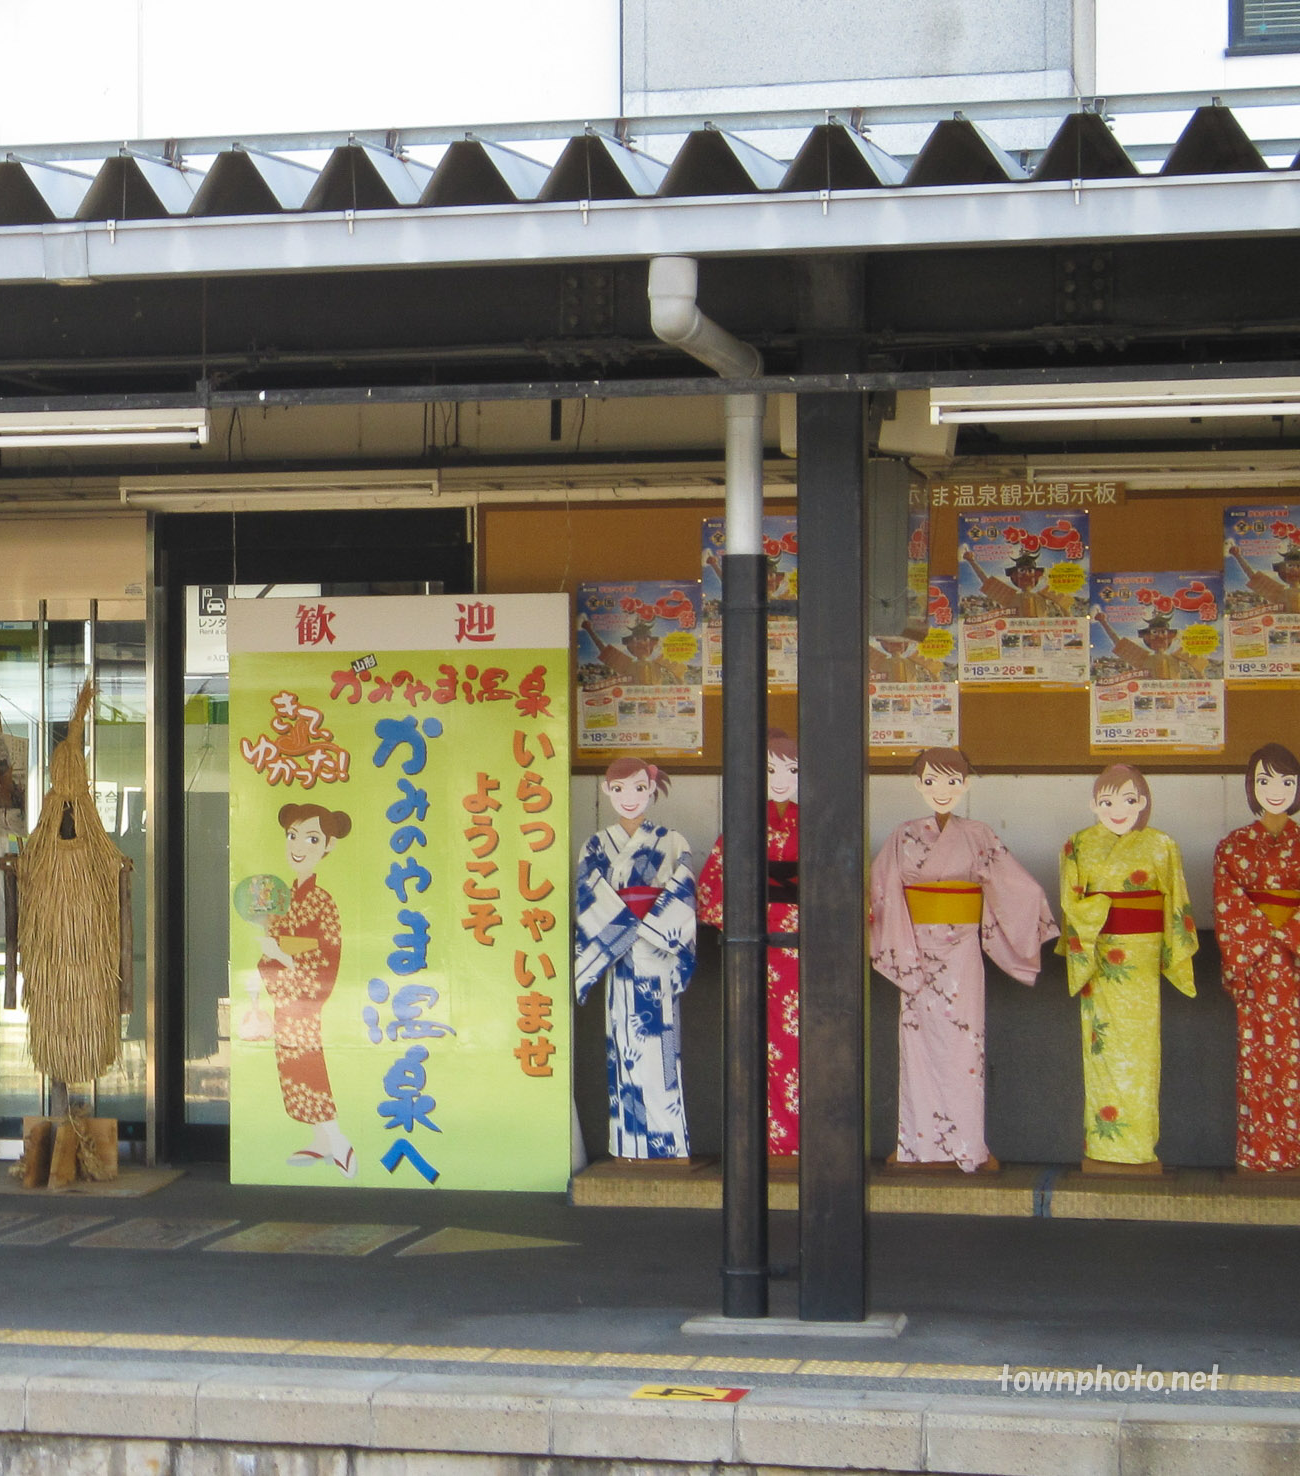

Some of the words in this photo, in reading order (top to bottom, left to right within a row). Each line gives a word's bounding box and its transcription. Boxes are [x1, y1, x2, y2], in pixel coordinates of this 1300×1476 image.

[329, 662, 552, 719] かみのやま温泉
[364, 715, 457, 1184] かみのやま温泉へ
[461, 773, 505, 947] ようこそ
[513, 729, 557, 1077] いらっしゃいませ
